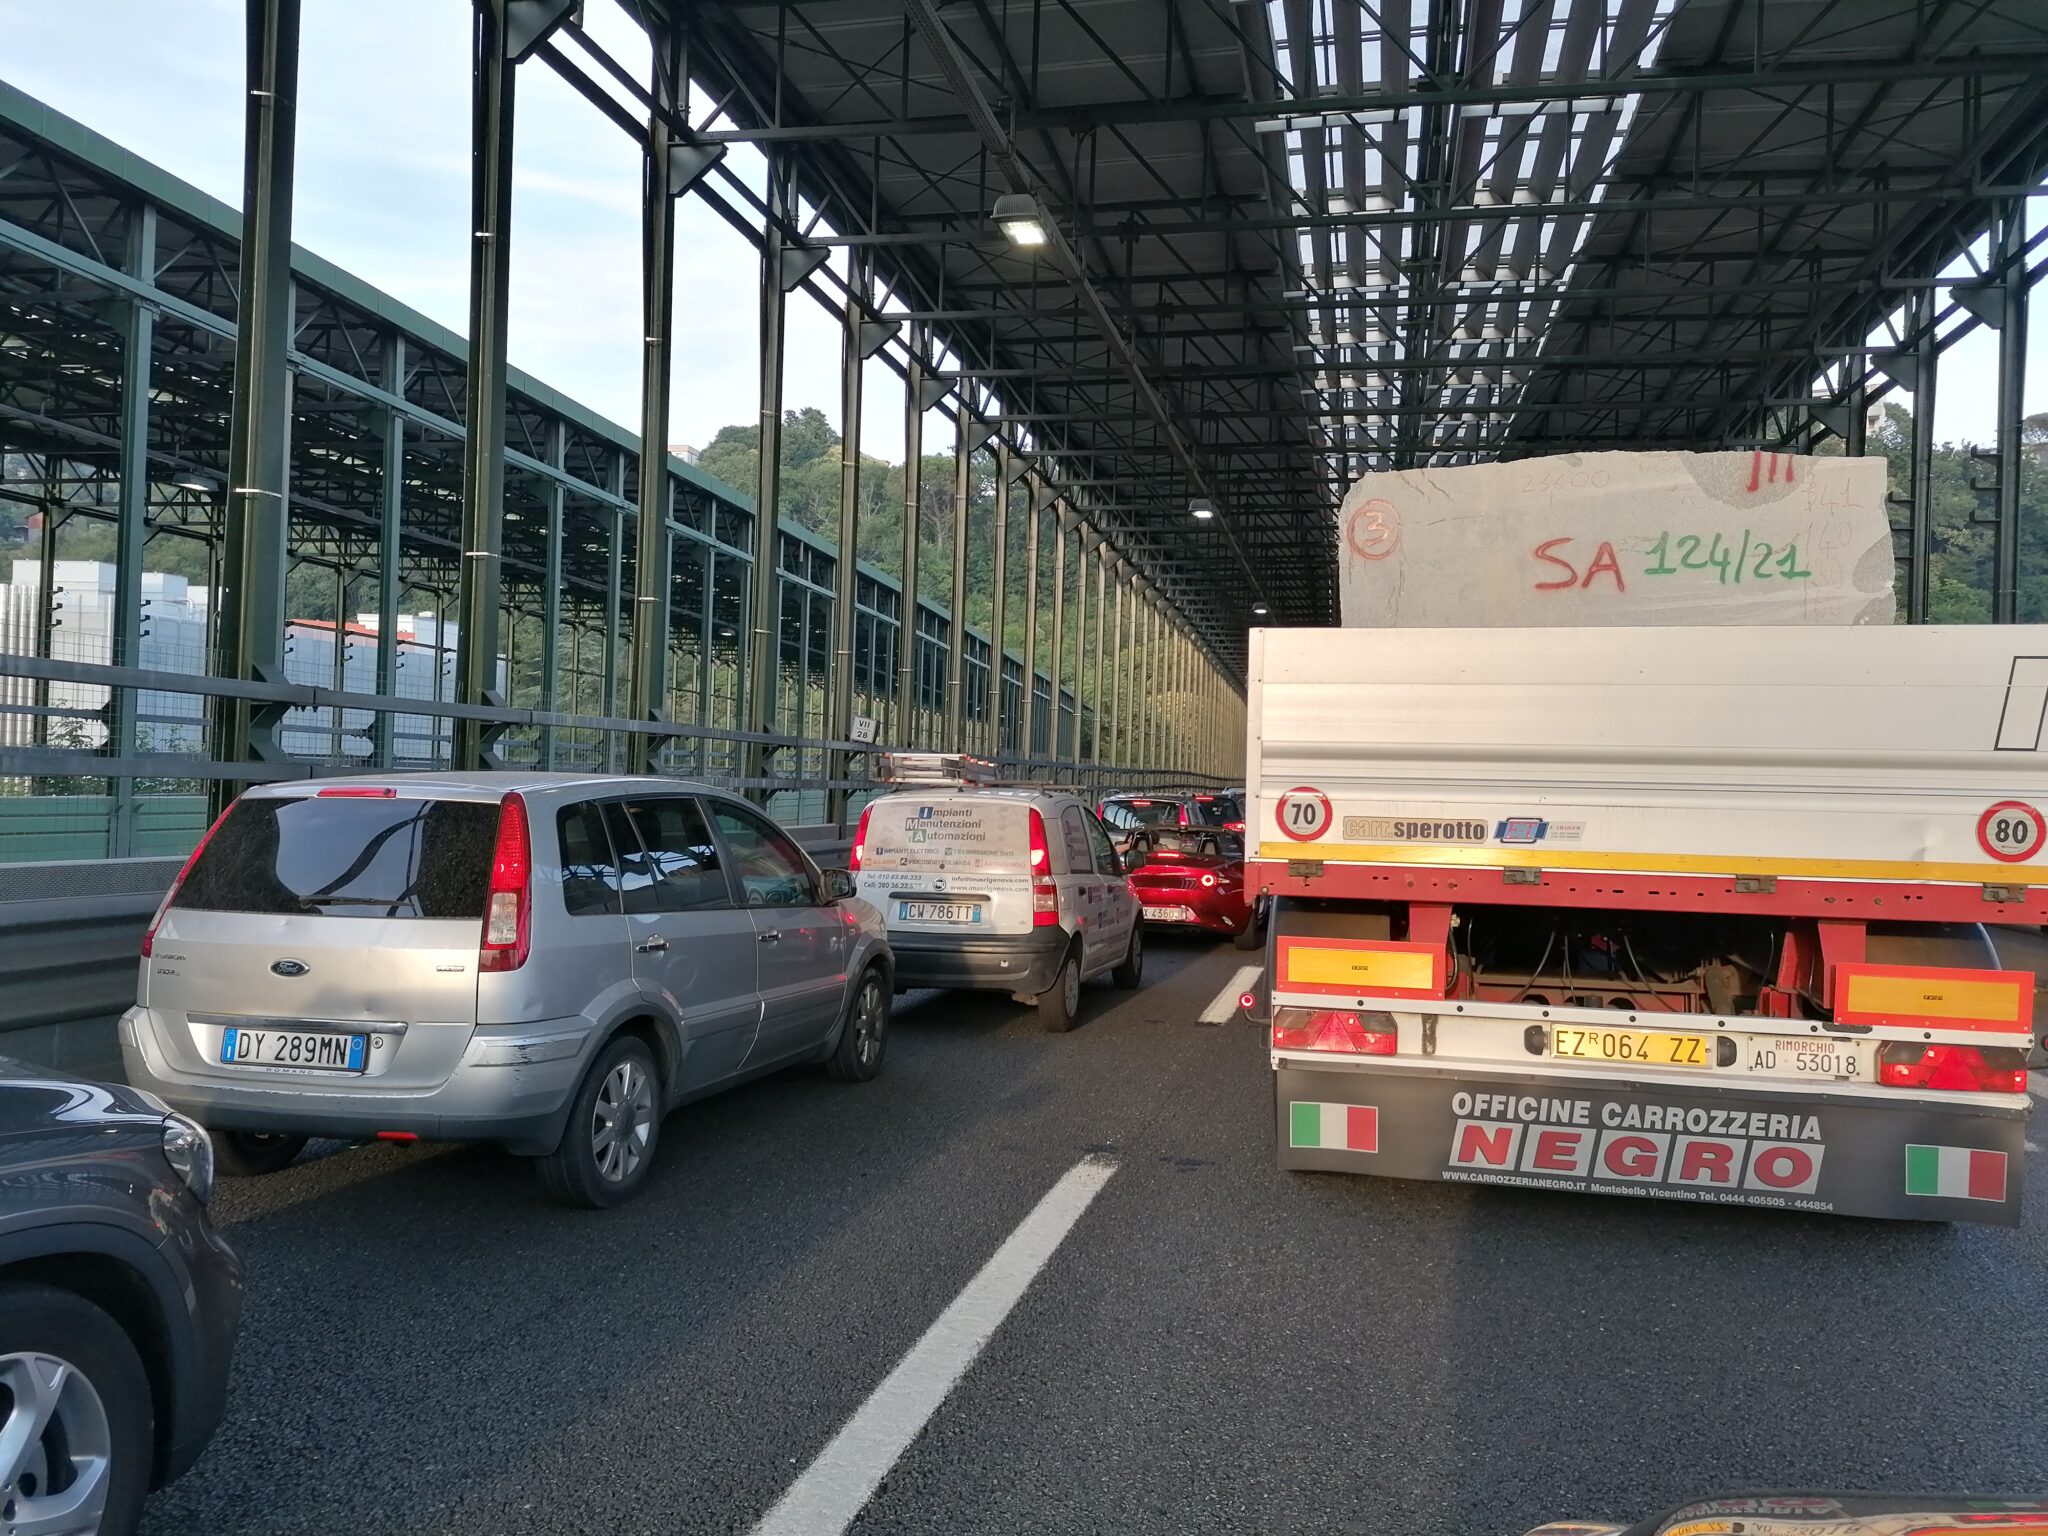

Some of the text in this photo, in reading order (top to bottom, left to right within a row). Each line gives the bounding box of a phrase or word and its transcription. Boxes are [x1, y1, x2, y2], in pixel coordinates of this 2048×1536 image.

[1535, 529, 1812, 593] SA 124/21
[906, 818, 982, 830] Manutenzioni
[922, 807, 973, 818] Impianti
[1291, 803, 1317, 826] 70
[914, 830, 986, 842] Automazioni
[1995, 818, 2028, 844] 80
[909, 904, 925, 918] CW
[929, 905, 972, 920] 786TT
[277, 961, 300, 975] Ford
[238, 1033, 266, 1059] DY
[274, 1035, 348, 1065] 289MN
[1670, 1038, 1701, 1064] ZZ
[1775, 1040, 1835, 1054] RIMORCHIO
[1754, 1051, 1857, 1075] AD 53018
[1451, 1091, 1822, 1141] OFFICINE CARROZZERIA
[1456, 1123, 1814, 1190] NEGRO
[1442, 1171, 1586, 1191] WWW.CARROZZERIANEGRO.IT
[1591, 1183, 1647, 1197] Montebello
[1649, 1187, 1697, 1200] Vicentino
[1699, 1191, 1718, 1201] Tel.
[1720, 1193, 1745, 1203] 0444
